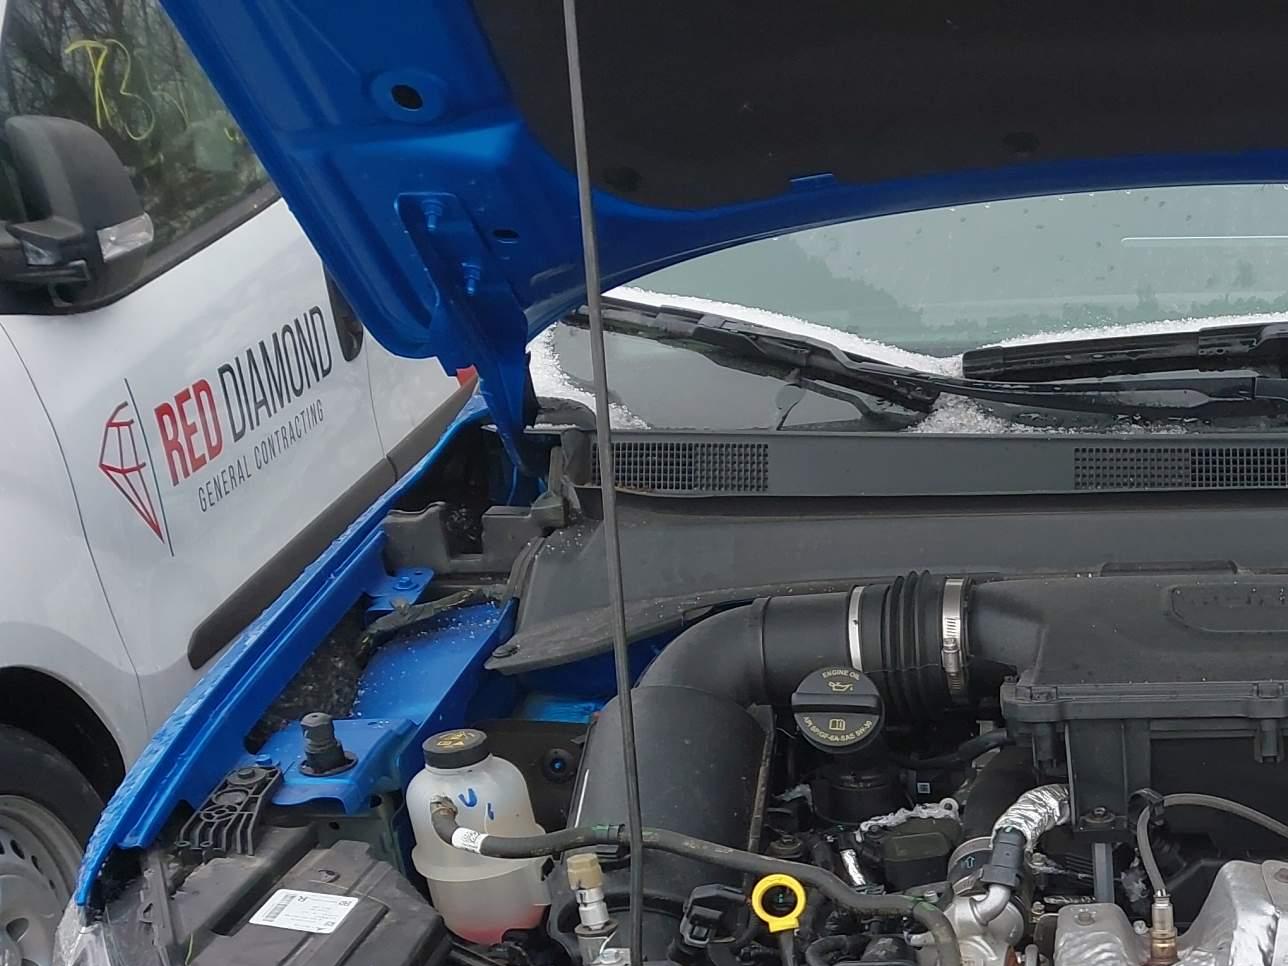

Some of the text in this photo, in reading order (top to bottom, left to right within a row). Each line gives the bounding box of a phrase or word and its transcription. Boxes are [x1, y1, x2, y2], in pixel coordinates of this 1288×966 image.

[154, 306, 333, 487] RED DIAMOND
[198, 399, 324, 512] GENERAL CONTRACTING
[822, 669, 860, 681] ENGINE OIL
